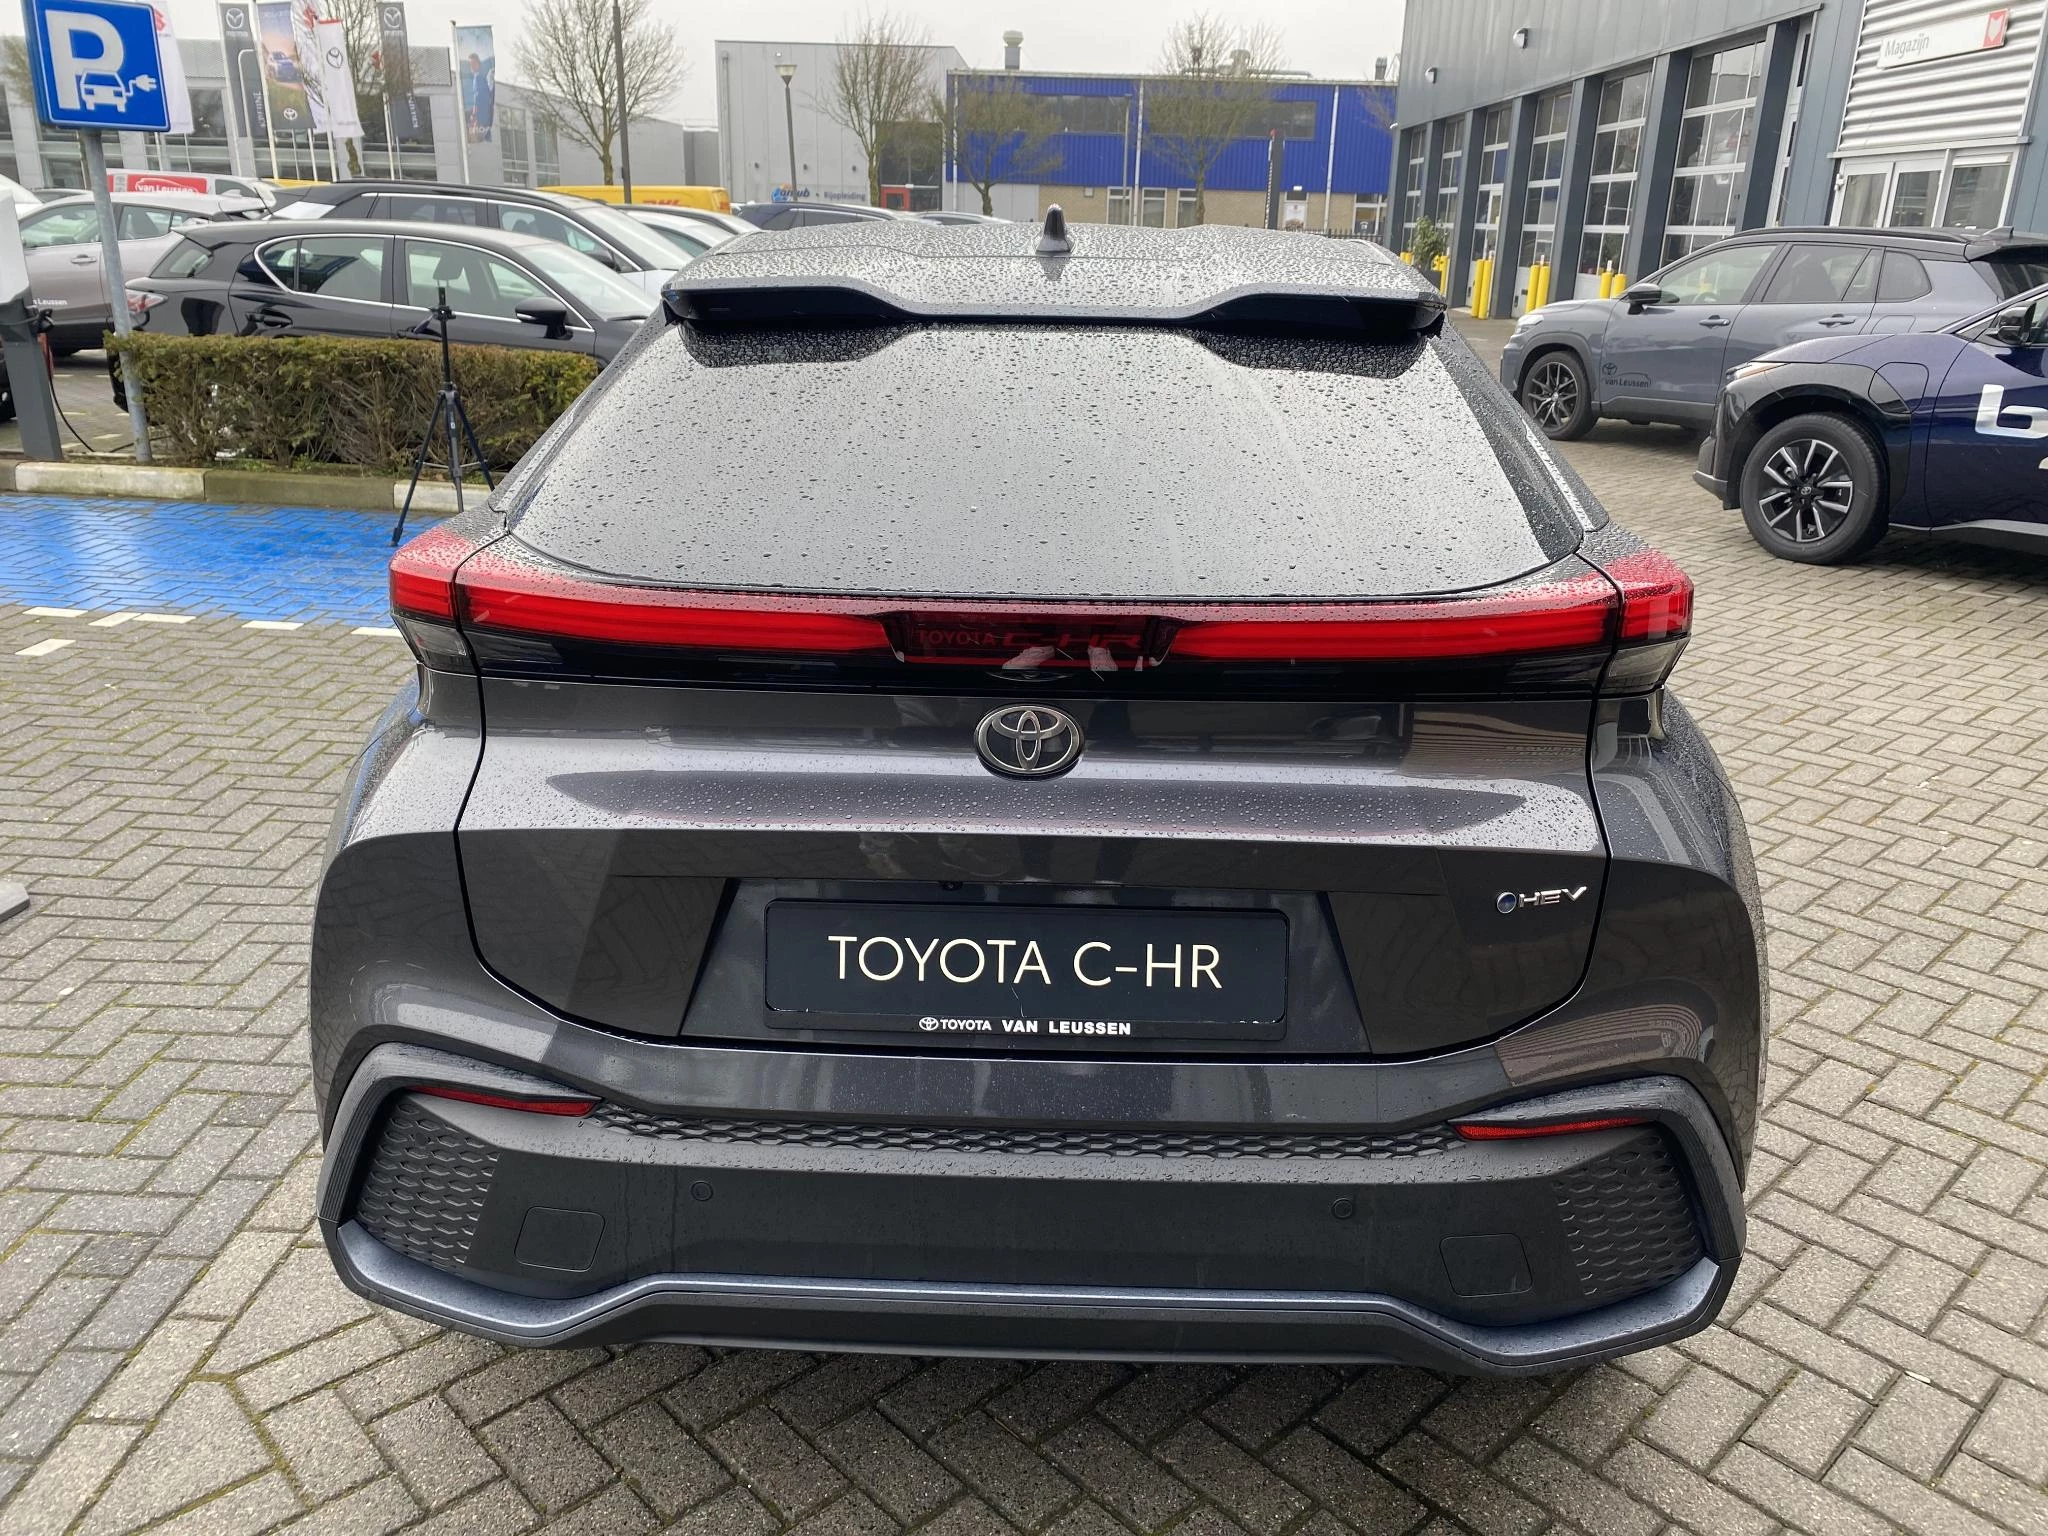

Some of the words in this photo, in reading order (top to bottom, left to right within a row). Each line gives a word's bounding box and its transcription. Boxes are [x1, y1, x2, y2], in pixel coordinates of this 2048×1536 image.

[1885, 33, 1929, 59] Magazijn
[45, 9, 125, 111] P
[1619, 379, 1649, 388] Leussen
[917, 630, 996, 645] TOYOTA
[1518, 886, 1588, 908] HEV
[828, 935, 1052, 985] TOYOTA
[1073, 941, 1223, 989] C-HR
[940, 1019, 992, 1031] TOYOTA
[1002, 1020, 1038, 1033] VAN
[1048, 1021, 1131, 1035] LEUSSEN
